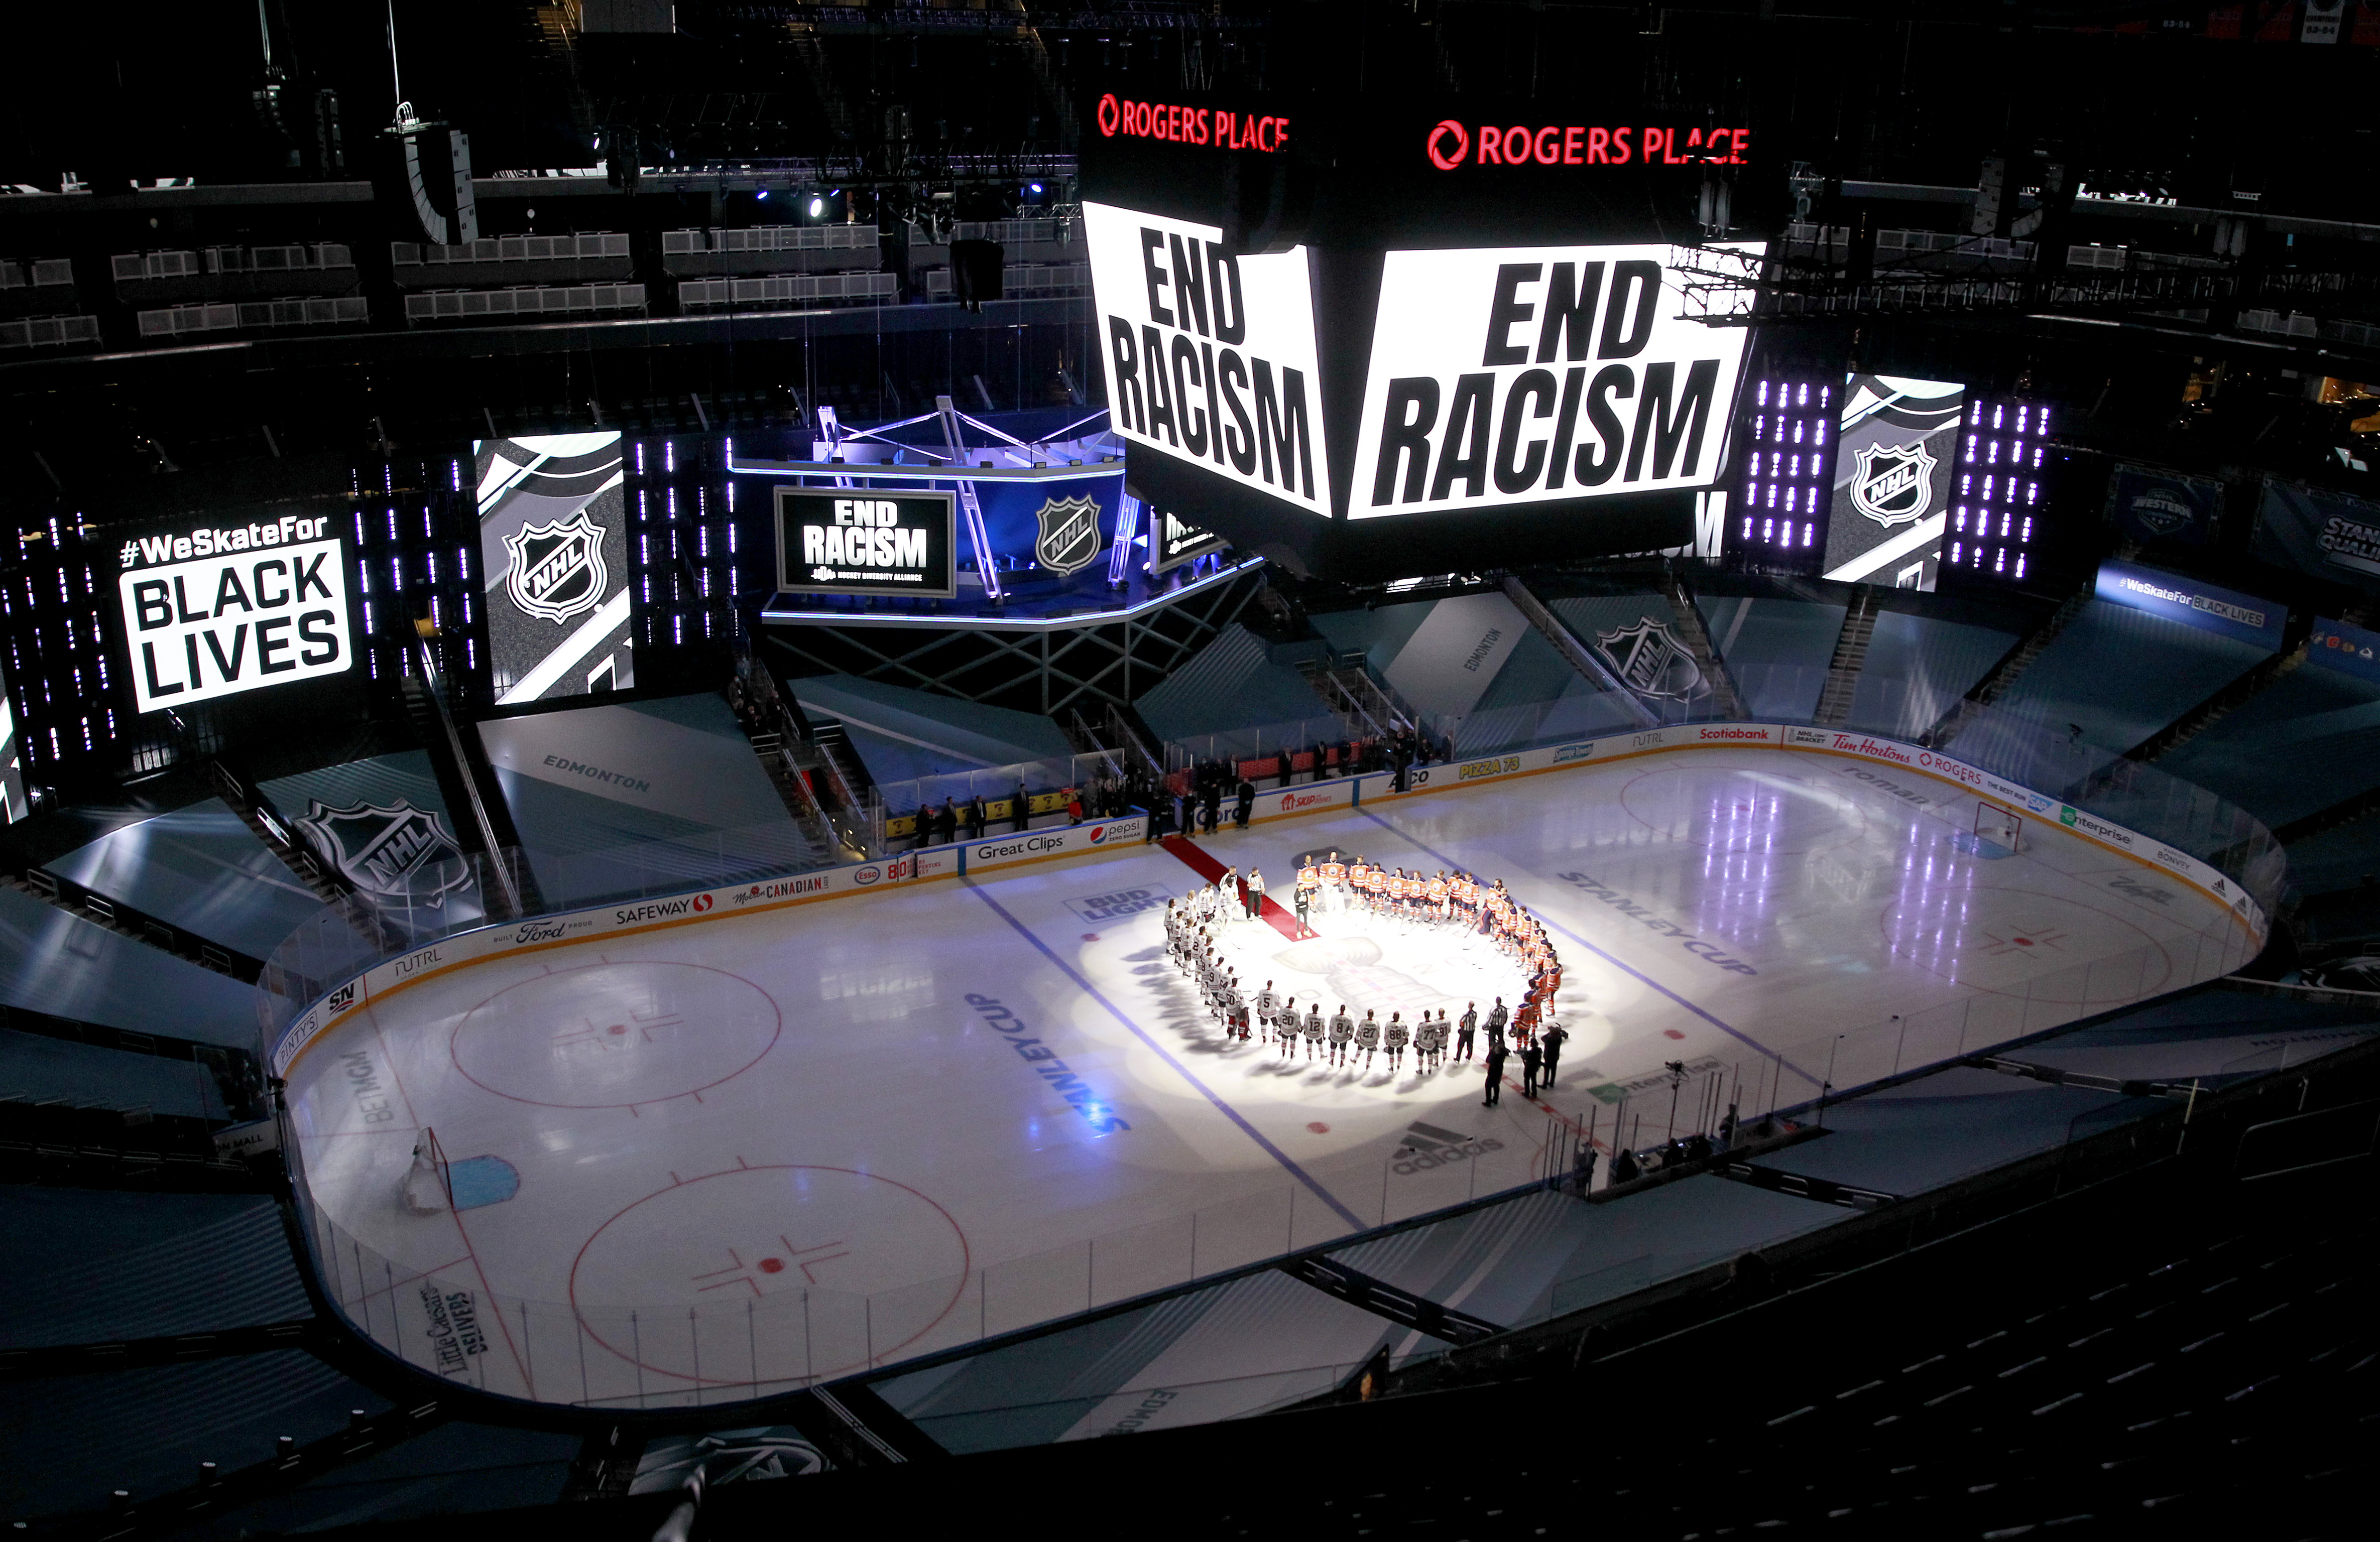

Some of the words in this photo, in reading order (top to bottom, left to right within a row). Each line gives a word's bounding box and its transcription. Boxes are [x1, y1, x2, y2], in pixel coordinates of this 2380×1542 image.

[1123, 100, 1208, 145] ROGERS
[1214, 111, 1290, 153] PLACE
[1478, 125, 1631, 164] ROGERS
[1643, 127, 1750, 165] PLACE
[1140, 227, 1245, 345] END
[1483, 260, 1662, 366] END
[1108, 315, 1316, 502] RACISM
[1371, 358, 1721, 507] RACISM
[1870, 466, 1916, 503] NHL
[834, 499, 898, 528] END
[119, 516, 328, 568] #WeSkateFor
[803, 525, 927, 568] RACISM
[1050, 516, 1088, 558] NHL
[532, 544, 583, 597] NHL
[837, 571, 861, 580] HOCKEY
[862, 572, 893, 580] DIVERSITY
[133, 552, 332, 631] BLACK
[2119, 577, 2193, 605] #WeSkateFor
[2194, 596, 2228, 615] BLACK
[2231, 607, 2262, 625] LIVES
[142, 609, 339, 699] LIVES
[1463, 627, 1502, 673] EDMONTON
[1628, 635, 1667, 687] NHL
[1700, 728, 1768, 740] Scotiabank
[1833, 733, 1857, 751] Tim
[1858, 739, 1911, 763] Hortons
[543, 754, 651, 794] EDMONTON
[1388, 770, 1429, 789] ACO
[1459, 759, 1502, 780] PIZZA
[1503, 756, 1520, 773] 73
[1935, 758, 1982, 785] ROGERS
[1296, 795, 1316, 807] SKIP
[1987, 781, 1998, 790] THE
[1999, 786, 2013, 795] BEST
[2013, 792, 2027, 801] RUN
[1108, 820, 1140, 838] pepsi
[1123, 832, 1141, 840] SUGAR
[2061, 809, 2131, 845] enterprise
[364, 823, 433, 885] NHL
[978, 842, 1024, 859] Great
[1027, 835, 1063, 852] Clips
[858, 870, 878, 880] Esso
[888, 861, 907, 879] 80
[766, 877, 822, 898] CANADIAN
[1084, 889, 1151, 909] BUD
[617, 899, 691, 925] SAFEWAY
[1083, 895, 1171, 921] LIGHT
[516, 921, 566, 944] Ford
[568, 921, 592, 929] PROUD
[1557, 871, 1696, 939] STANLEY
[1684, 941, 1757, 975] CUP
[494, 934, 513, 943] BUILT
[329, 982, 354, 1011] SN
[1263, 997, 1270, 1008] 5
[964, 992, 1025, 1033] CUP
[1282, 1014, 1294, 1026] 20
[1309, 1021, 1321, 1032] 12
[281, 1015, 315, 1063] PINTY'S
[1337, 1022, 1344, 1033] 8
[1363, 1027, 1376, 1038] 27
[1389, 1030, 1401, 1040] 88
[1423, 1029, 1436, 1040] 77
[1004, 1036, 1131, 1133] STANLEY
[234, 1133, 263, 1147] MALL
[1392, 1137, 1504, 1176] adidas
